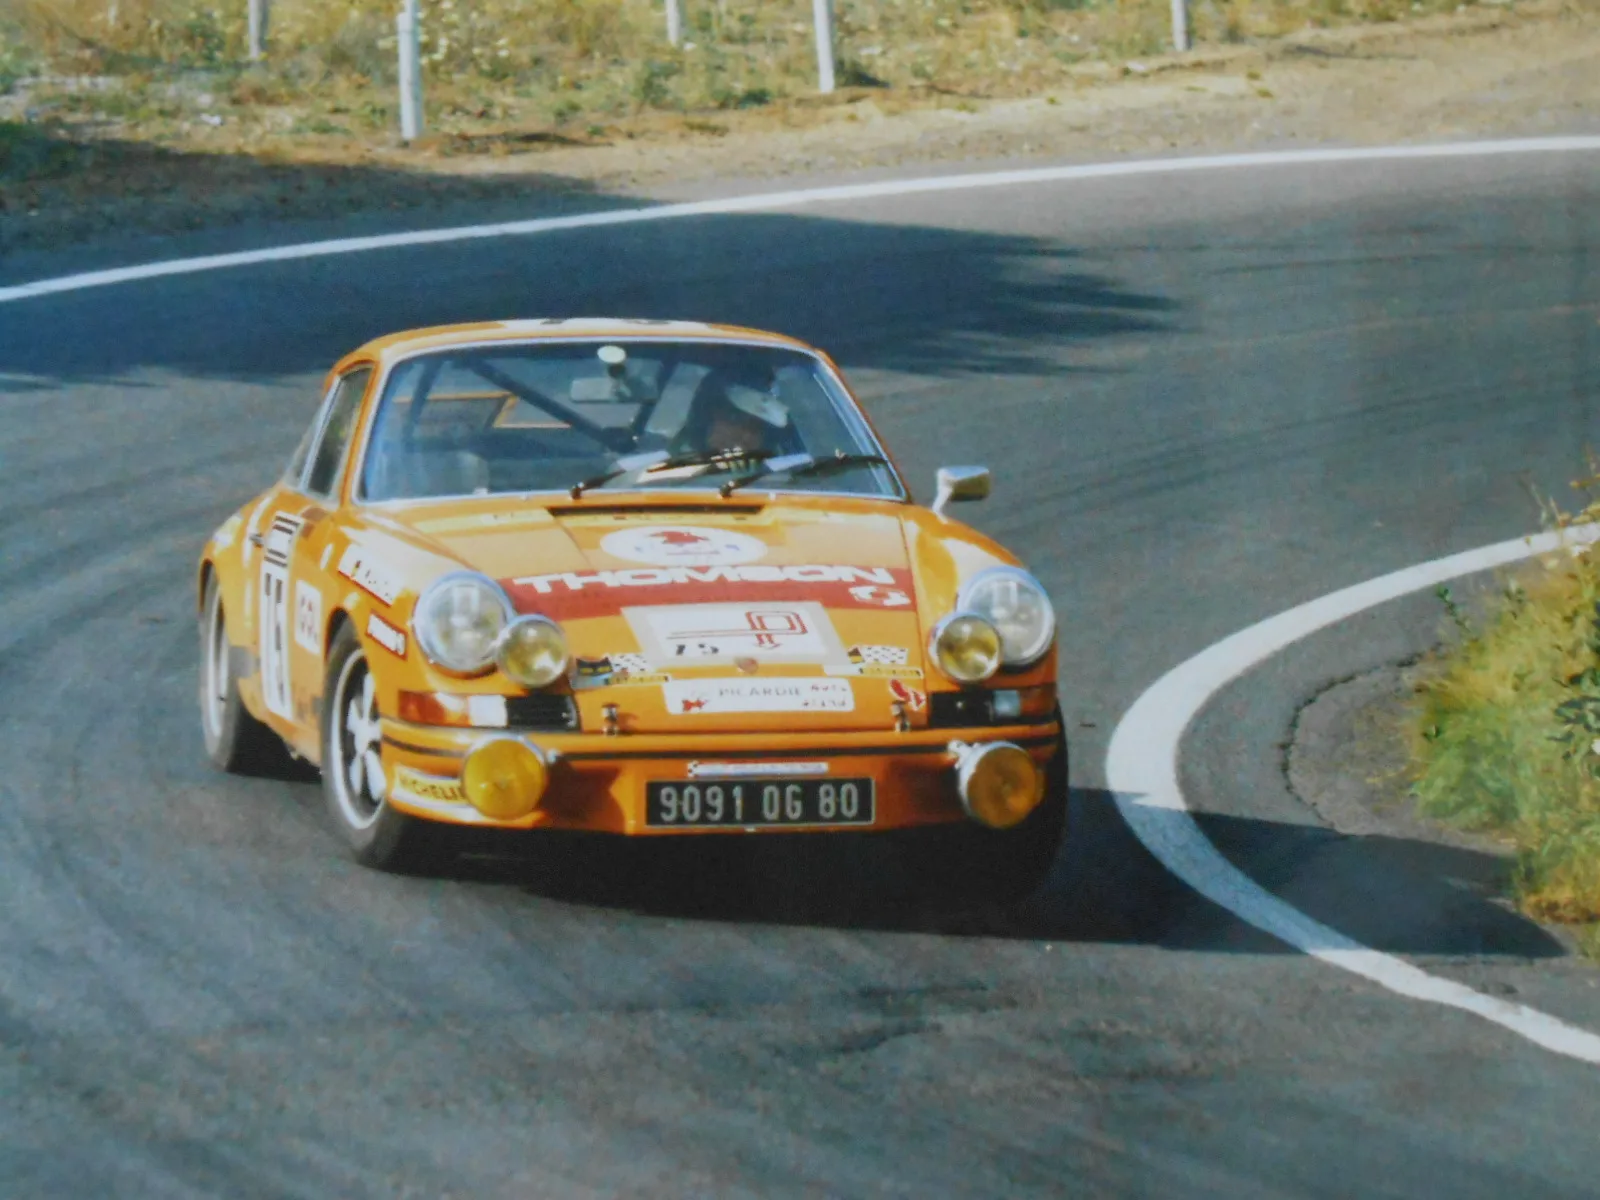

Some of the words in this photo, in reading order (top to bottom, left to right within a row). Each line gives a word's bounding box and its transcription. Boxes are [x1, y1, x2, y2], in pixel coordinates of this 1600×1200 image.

[511, 565, 897, 593] THOMSON
[659, 785, 744, 822] 9091
[818, 782, 859, 819] 80
